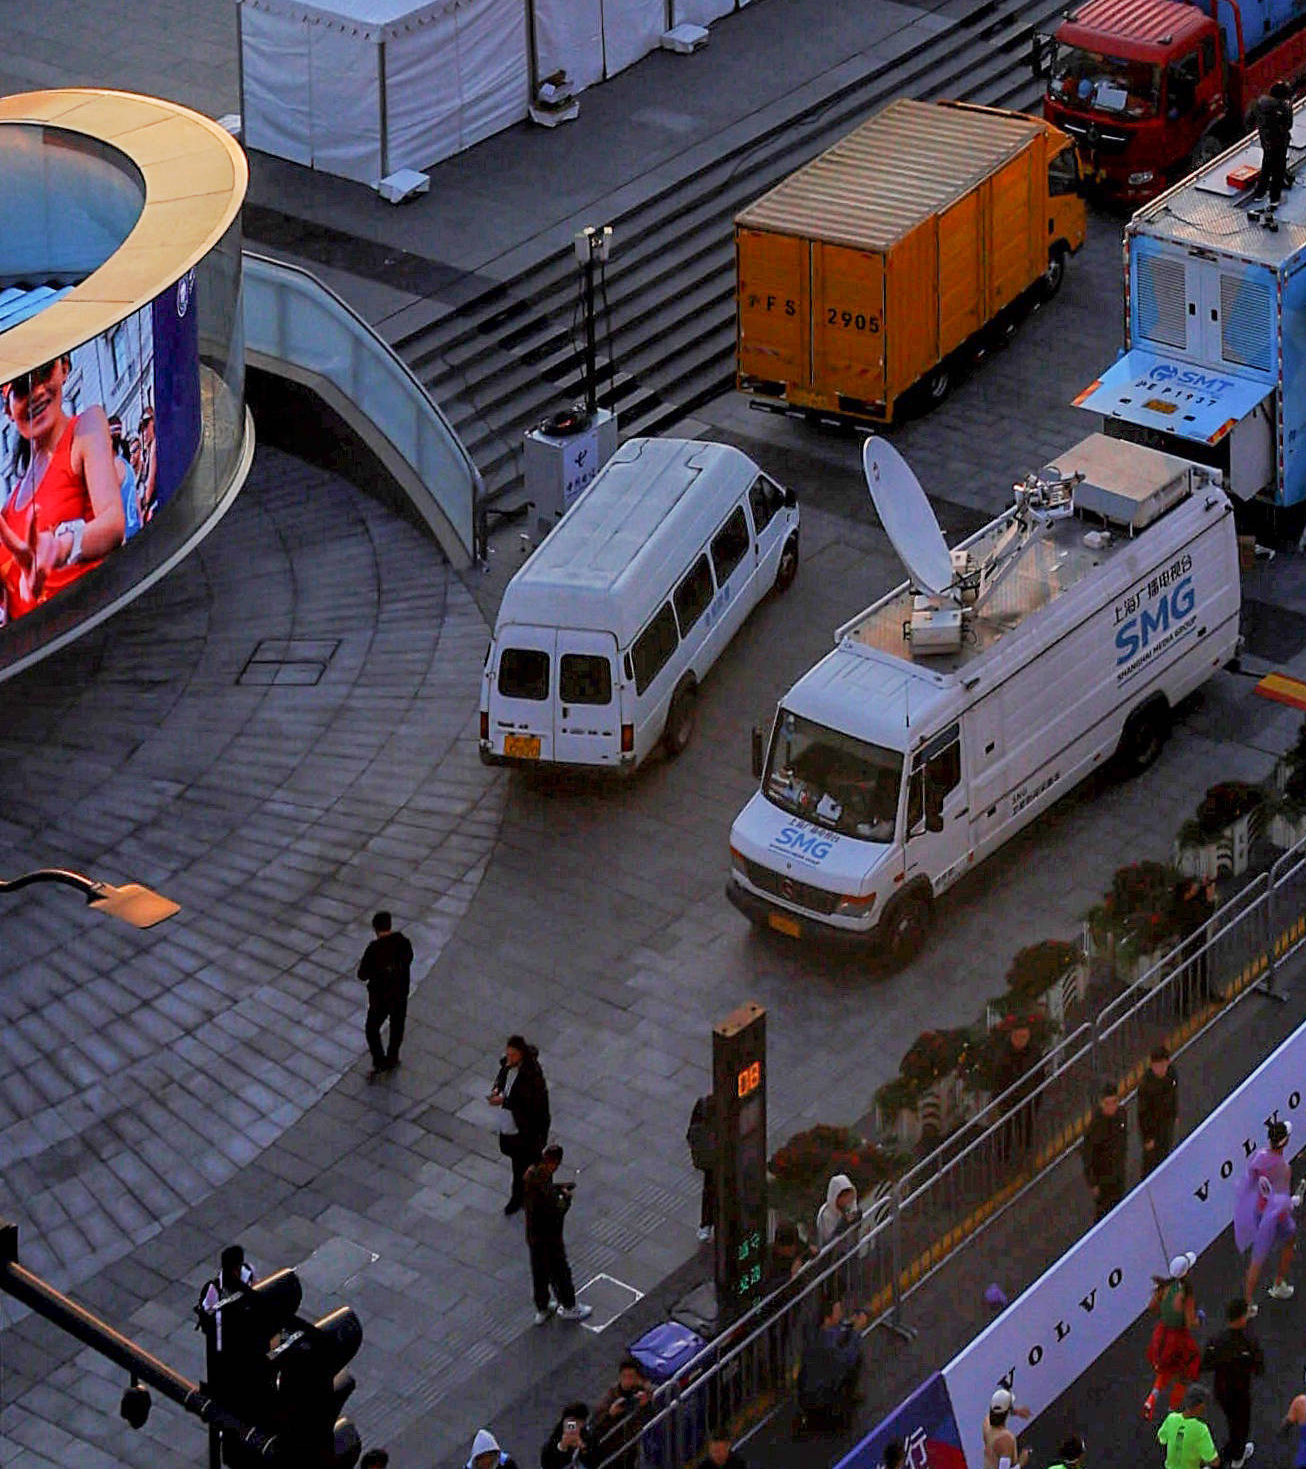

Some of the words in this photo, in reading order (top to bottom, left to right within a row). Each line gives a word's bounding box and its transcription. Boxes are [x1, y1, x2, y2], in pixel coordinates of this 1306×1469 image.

[827, 308, 880, 333] 2905
[1178, 371, 1235, 392] SMT
[1113, 554, 1192, 627] 上海广播电视台
[1115, 576, 1195, 666] SMG
[1153, 634, 1174, 653] MEDIA
[775, 828, 833, 860] SMG
[1194, 1091, 1301, 1203] VOLVO
[997, 1268, 1123, 1390] VOLVO
